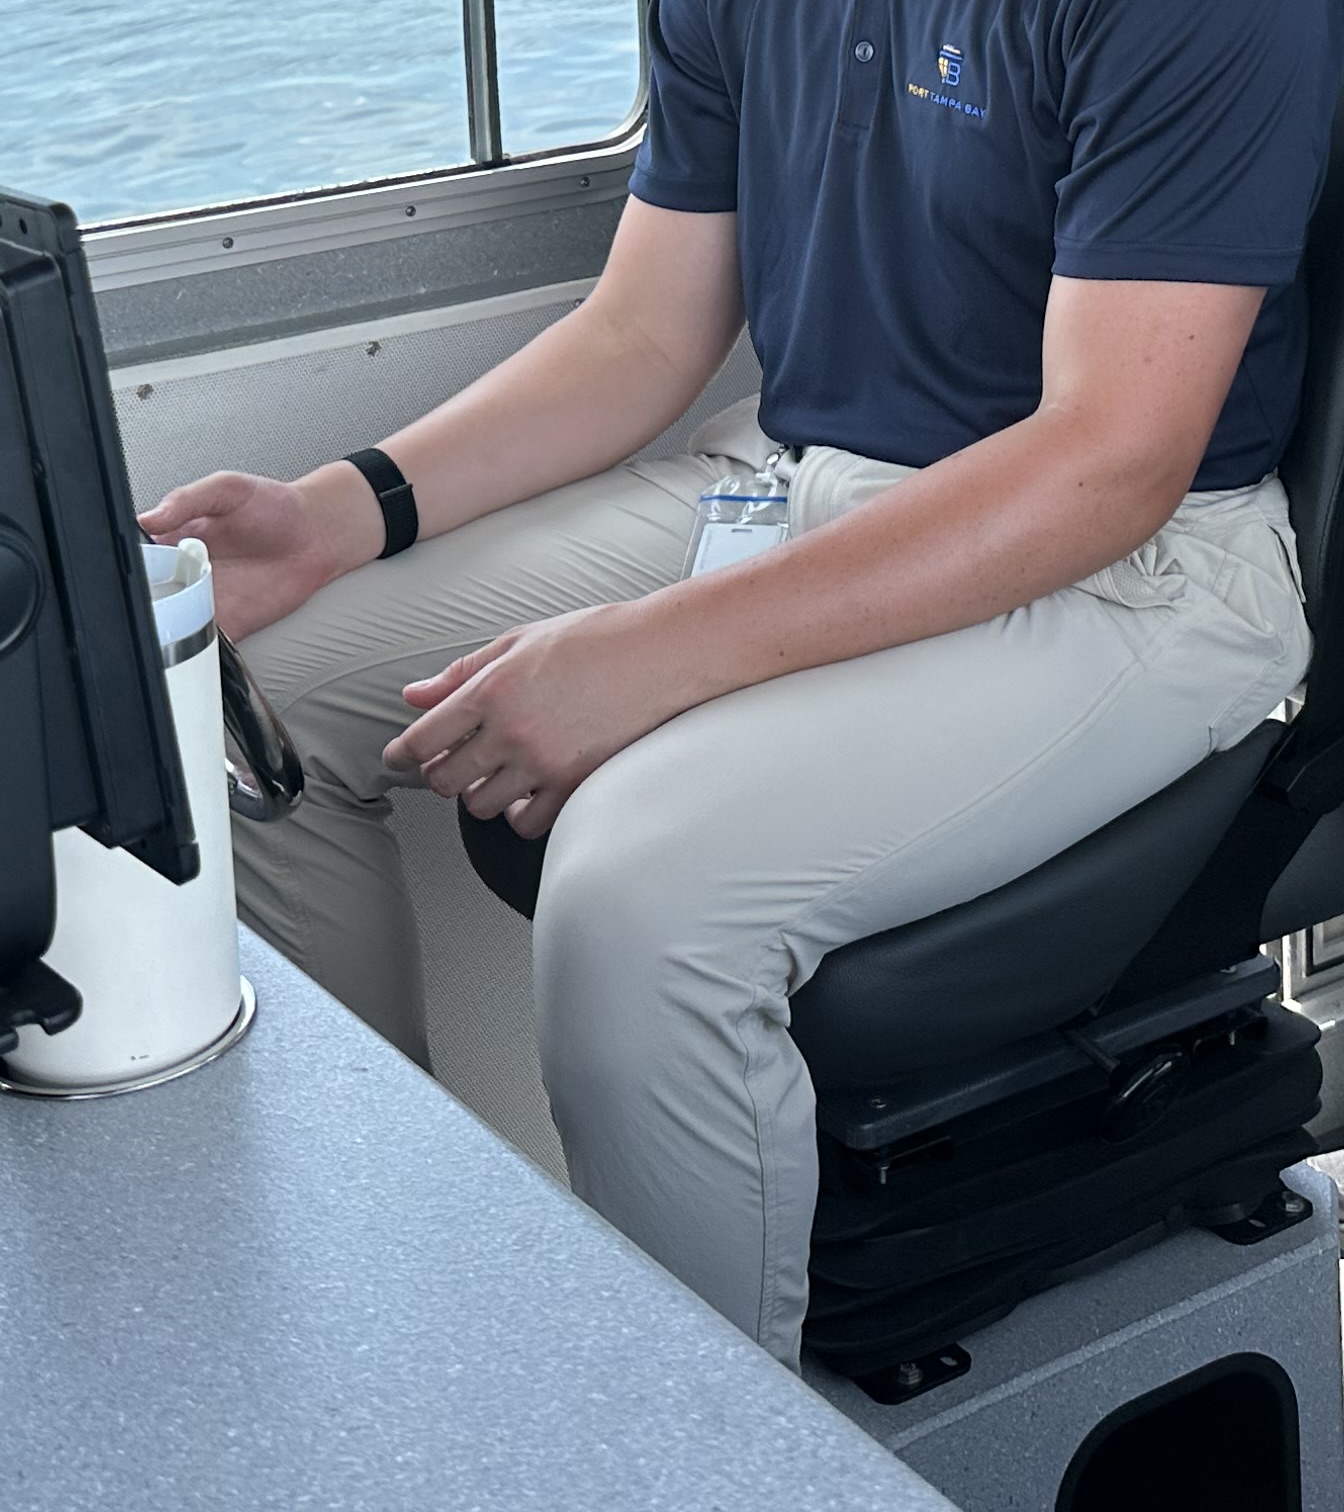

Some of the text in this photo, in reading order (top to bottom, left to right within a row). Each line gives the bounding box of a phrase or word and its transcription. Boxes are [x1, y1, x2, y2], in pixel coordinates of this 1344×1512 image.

[908, 83, 988, 119] PORT TAMPA BAY
